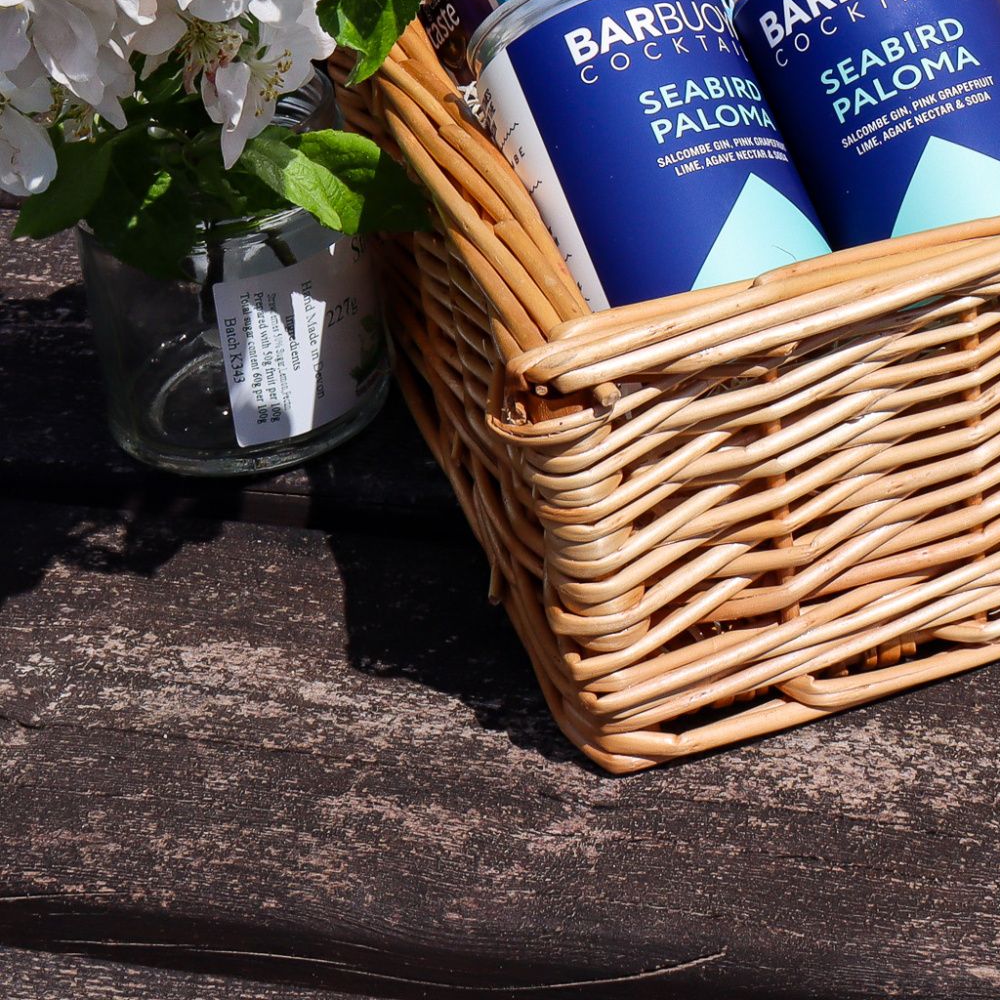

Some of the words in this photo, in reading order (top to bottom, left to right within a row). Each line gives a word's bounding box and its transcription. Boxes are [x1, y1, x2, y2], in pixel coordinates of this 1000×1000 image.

[564, 0, 739, 66] BARBUOY
[580, 35, 749, 84] COCKTAIL
[820, 17, 964, 95] SEABIRD
[638, 75, 763, 114] SEABIRD
[832, 46, 981, 124] PALOMA
[650, 103, 776, 145] PALOMA
[841, 117, 891, 149] SALCOMBE
[889, 105, 912, 122] GIN,
[912, 92, 938, 112] PINK
[938, 75, 995, 101] GRAPEFRUIT
[856, 136, 882, 157] LIME,
[883, 119, 914, 142] AGAVE
[914, 102, 954, 127] NECTAR
[955, 99, 964, 109] &
[964, 91, 992, 108] SODA
[656, 142, 713, 168] SALCOMBE
[713, 140, 733, 151] GIN,
[733, 136, 754, 147] PINK
[674, 159, 705, 177] LIME,
[705, 154, 736, 168] AGAVE
[736, 149, 766, 161] NECTAR
[238, 292, 252, 314] Total
[251, 292, 269, 329] Prepared
[301, 280, 315, 312] Hand
[222, 317, 241, 350] Batch
[240, 317, 253, 339] sugar
[258, 330, 271, 349] with
[285, 314, 300, 371] Ingredients
[306, 313, 319, 346] Made
[229, 352, 246, 383] K343
[247, 340, 261, 369] content
[259, 350, 274, 366] 50g
[311, 349, 319, 361] in
[250, 371, 263, 388] 60g
[264, 367, 278, 385] fruit
[313, 361, 325, 399] Devon
[253, 389, 263, 402] per
[266, 387, 278, 401] per
[254, 404, 269, 424] 100g
[268, 402, 282, 422] 100g
